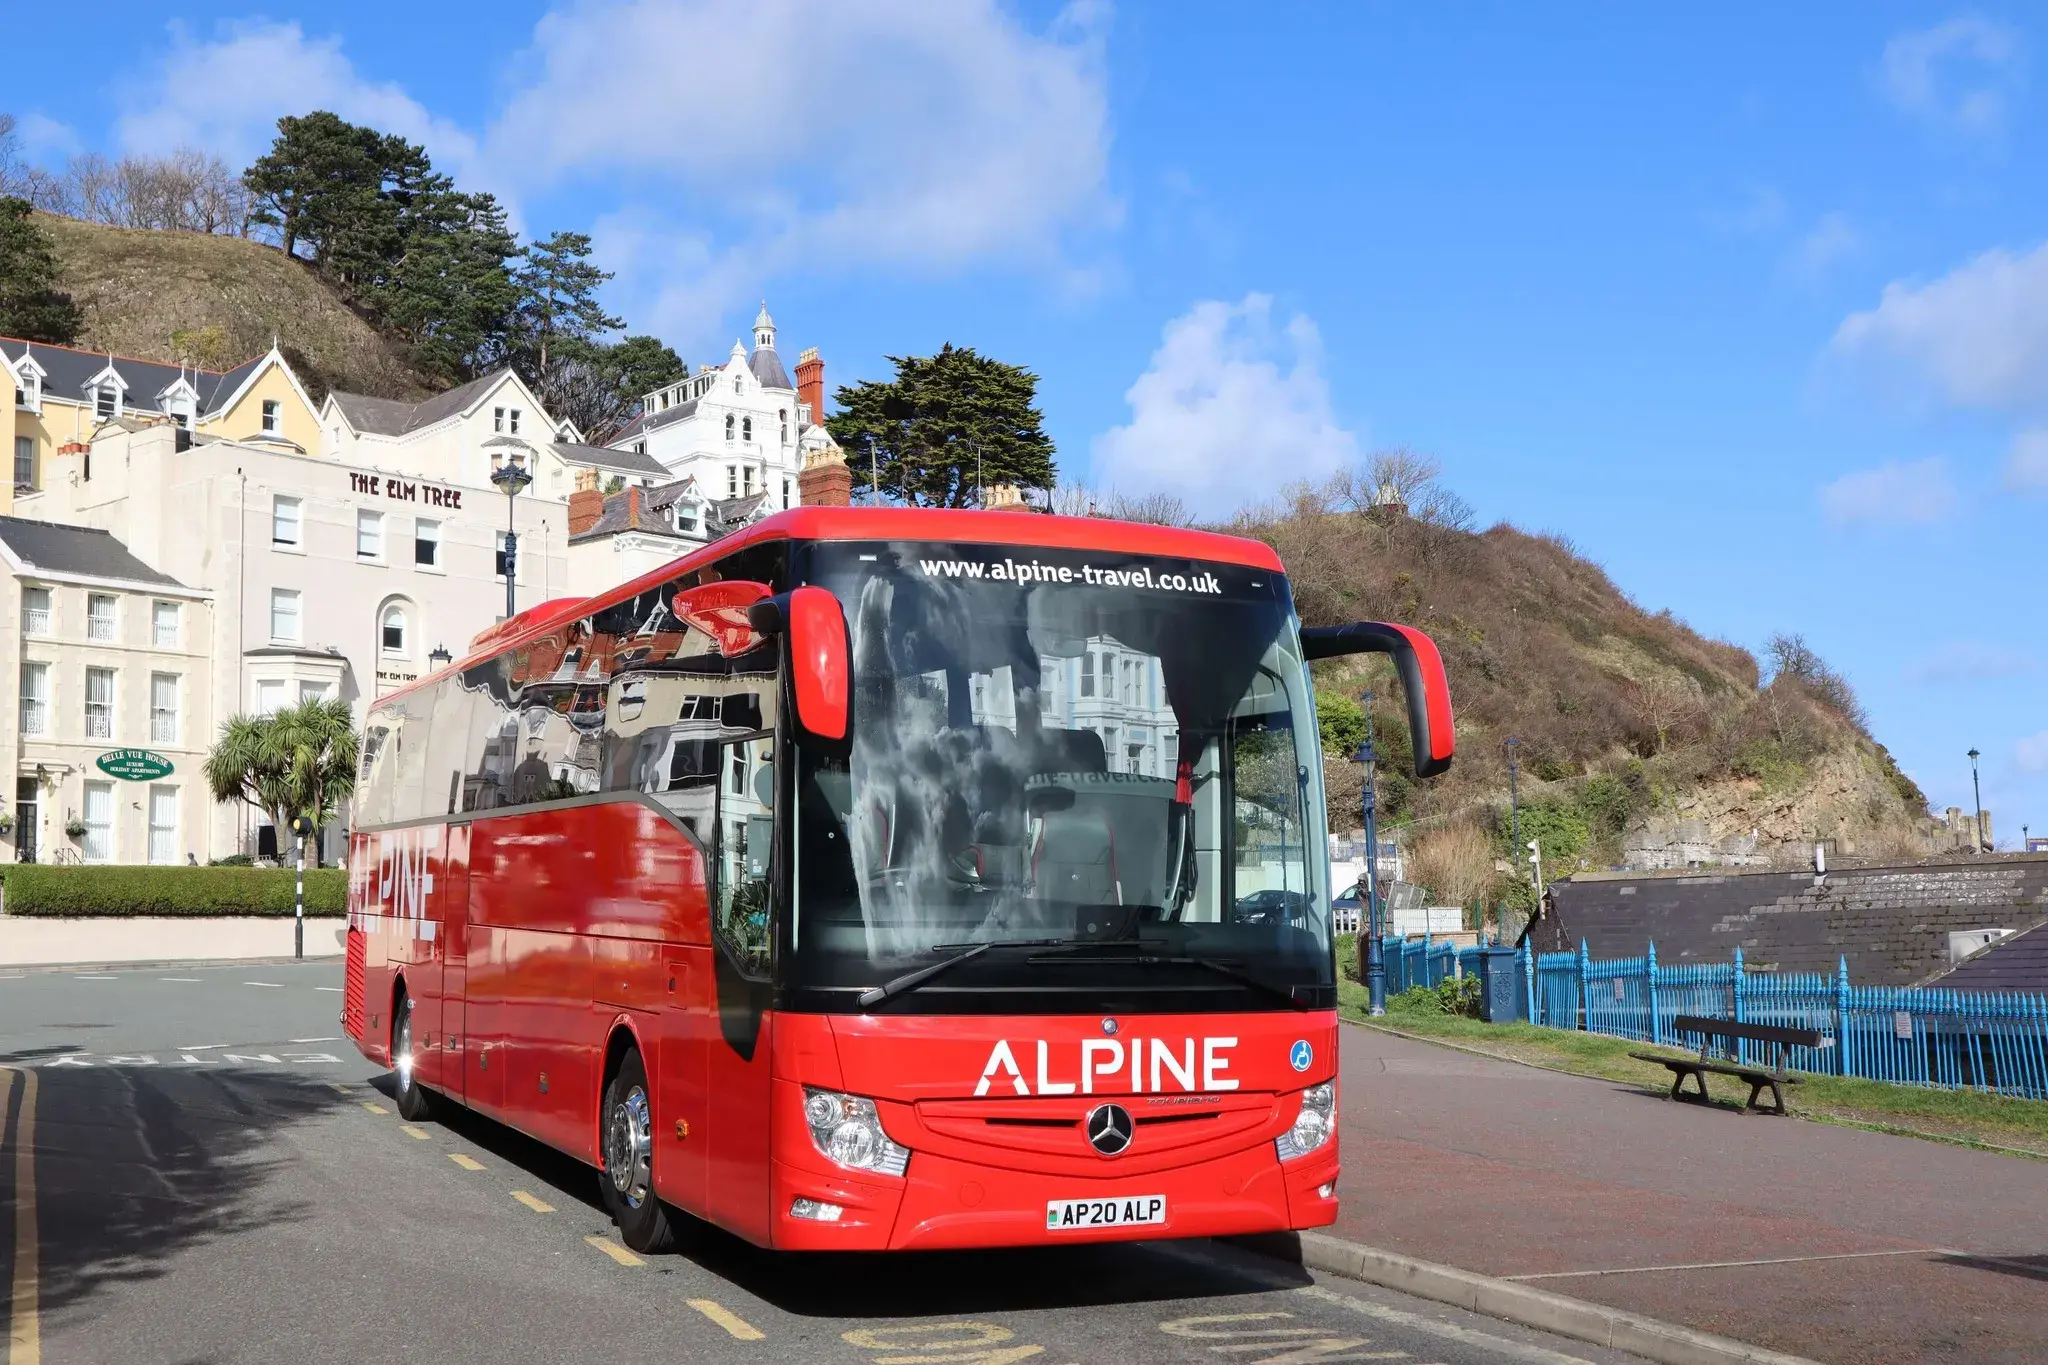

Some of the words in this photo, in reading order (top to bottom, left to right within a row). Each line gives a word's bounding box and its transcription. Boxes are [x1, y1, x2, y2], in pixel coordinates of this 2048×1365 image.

[349, 472, 379, 495] THE
[386, 479, 416, 502] ELM
[422, 485, 462, 509] TREE
[919, 558, 1222, 595] www.alpine-travel.co.uk
[101, 751, 124, 764] BELLE
[127, 751, 143, 759] VUE
[145, 752, 169, 768] HOUSE
[347, 828, 440, 942] ALPINE
[973, 1037, 1240, 1096] ALPINE
[1062, 1202, 1117, 1226] AP20
[1123, 1199, 1161, 1222] ALP
